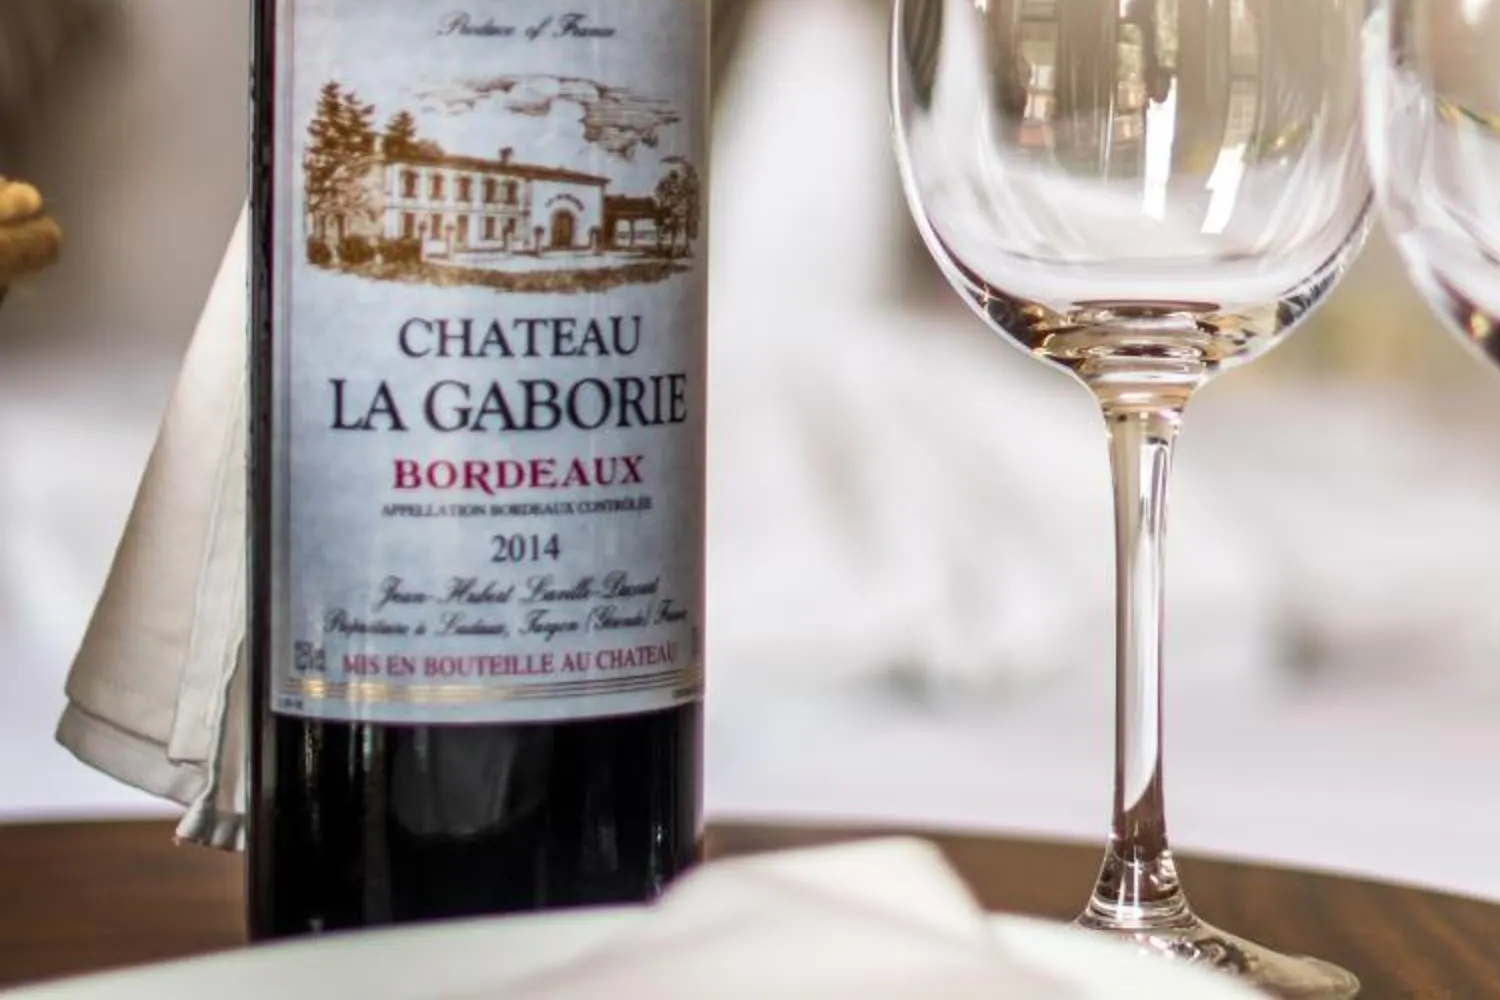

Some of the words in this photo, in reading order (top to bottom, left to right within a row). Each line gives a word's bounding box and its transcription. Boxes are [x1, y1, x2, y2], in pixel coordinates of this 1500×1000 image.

[399, 315, 643, 358] CHATEAU
[328, 377, 408, 431] LA
[423, 373, 688, 433] GABORIE
[392, 455, 646, 495] BORDEAUX
[381, 503, 488, 518] APPELLATION
[489, 500, 576, 517] BORDEAUX
[490, 533, 562, 563] 2014
[342, 653, 380, 676] MIS
[385, 654, 416, 677] EN
[422, 653, 555, 678] BOUTEILLE
[560, 649, 594, 672] AU
